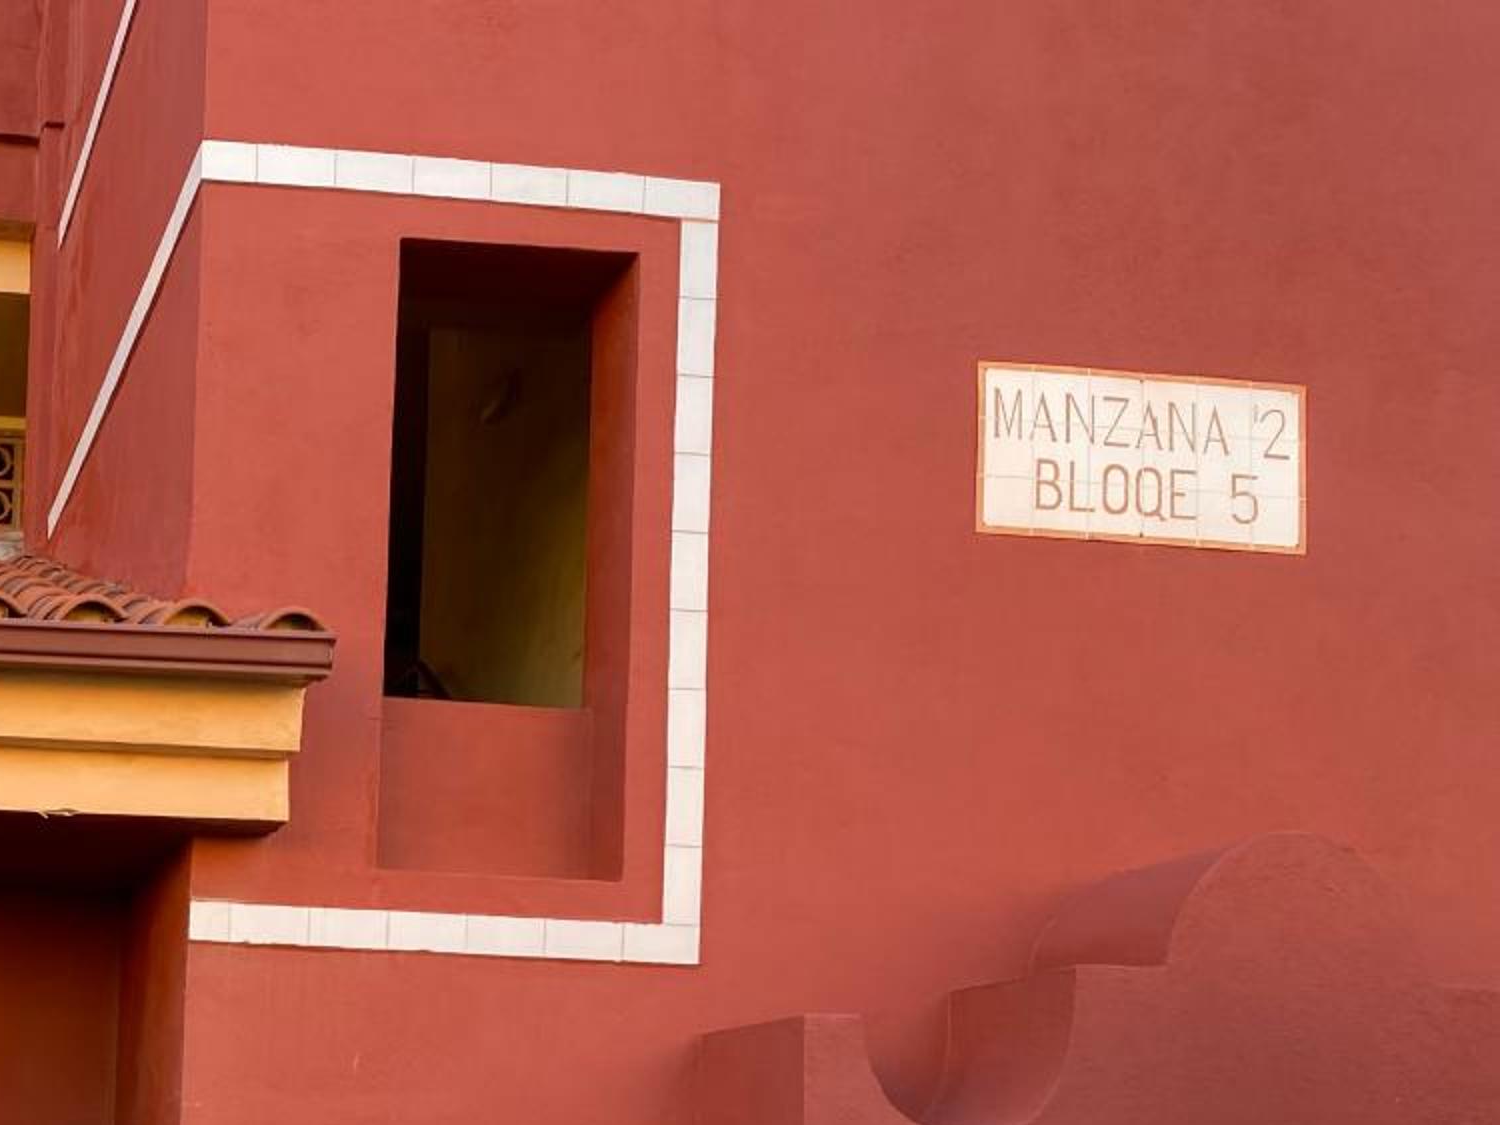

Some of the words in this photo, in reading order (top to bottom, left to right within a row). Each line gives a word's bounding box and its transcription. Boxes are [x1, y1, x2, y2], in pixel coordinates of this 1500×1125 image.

[993, 386, 1230, 456] MANZANA
[1259, 408, 1291, 460] 2
[1035, 457, 1198, 521] BLOQE
[1230, 473, 1260, 525] 5
